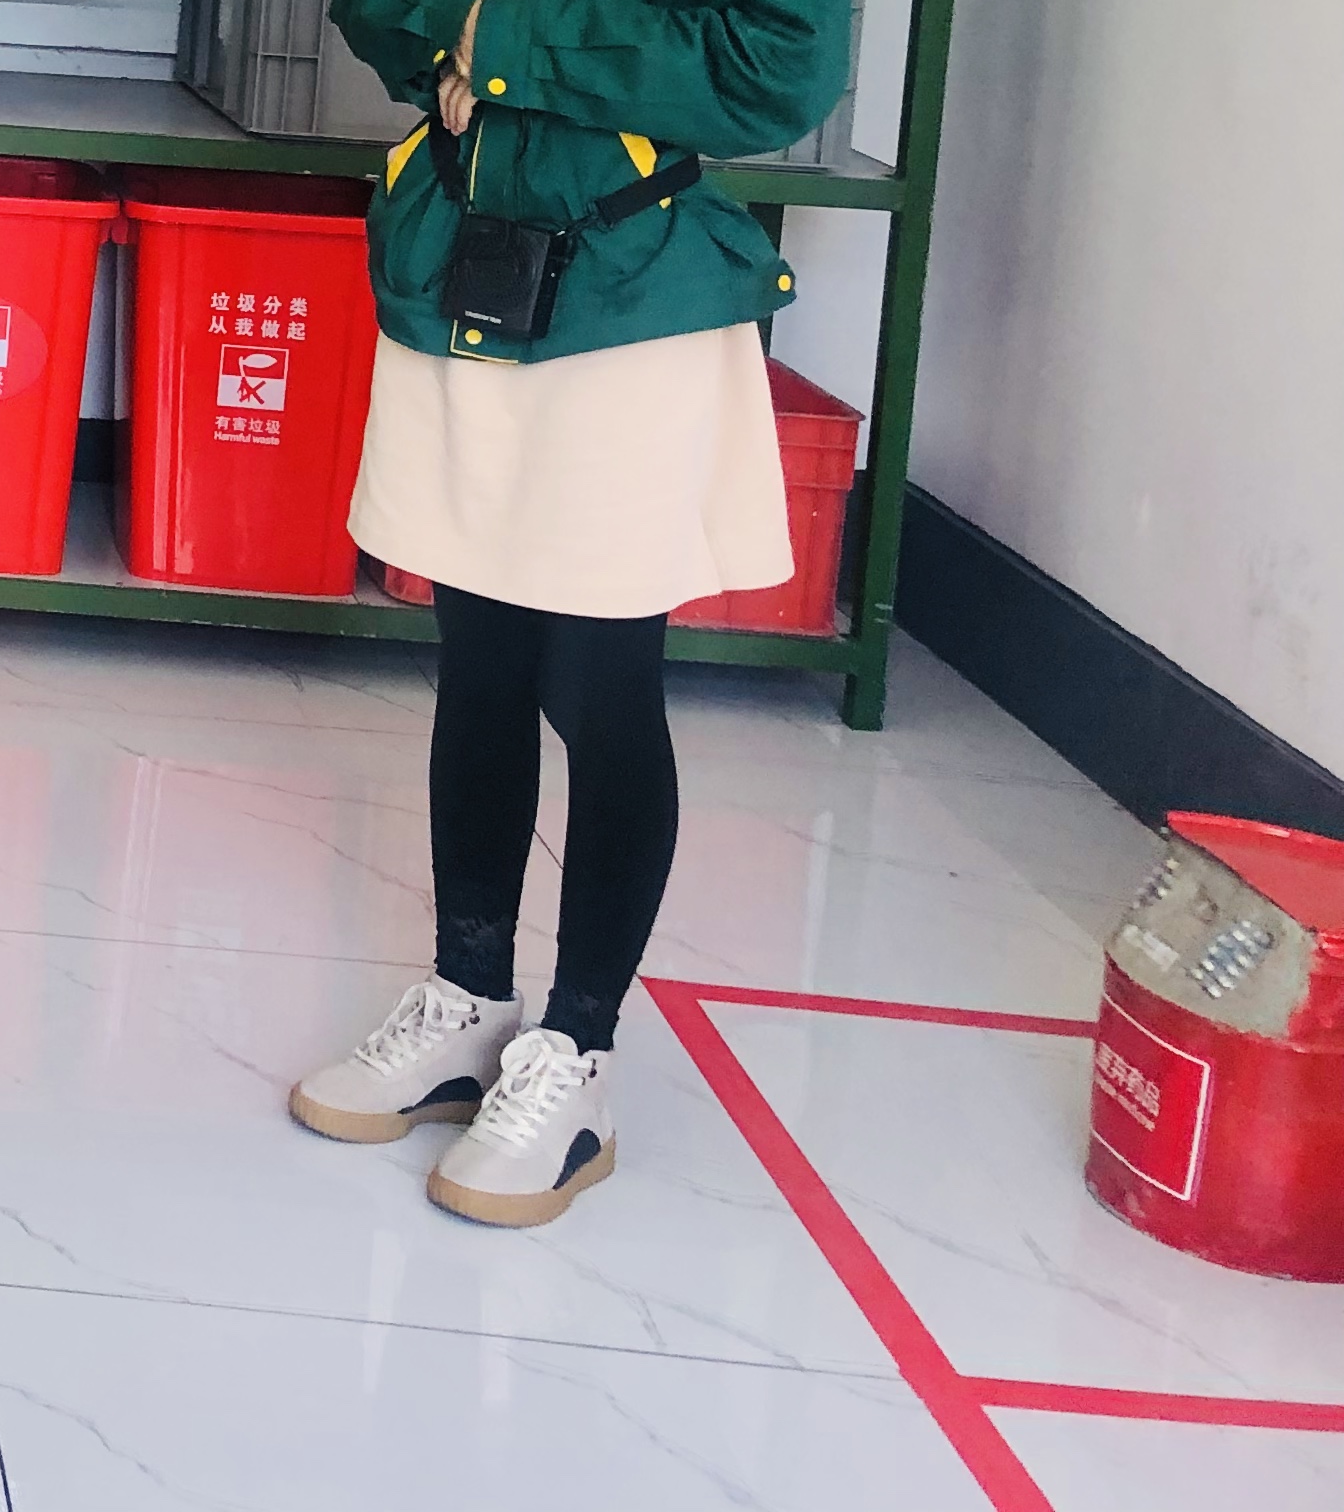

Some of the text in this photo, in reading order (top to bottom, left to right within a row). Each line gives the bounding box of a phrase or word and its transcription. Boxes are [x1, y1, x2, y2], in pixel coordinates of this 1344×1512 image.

[210, 293, 308, 317] 垃圾分类
[208, 316, 306, 341] 从我做起
[215, 415, 280, 435] 有害垃圾
[214, 430, 280, 446] Harmful waste
